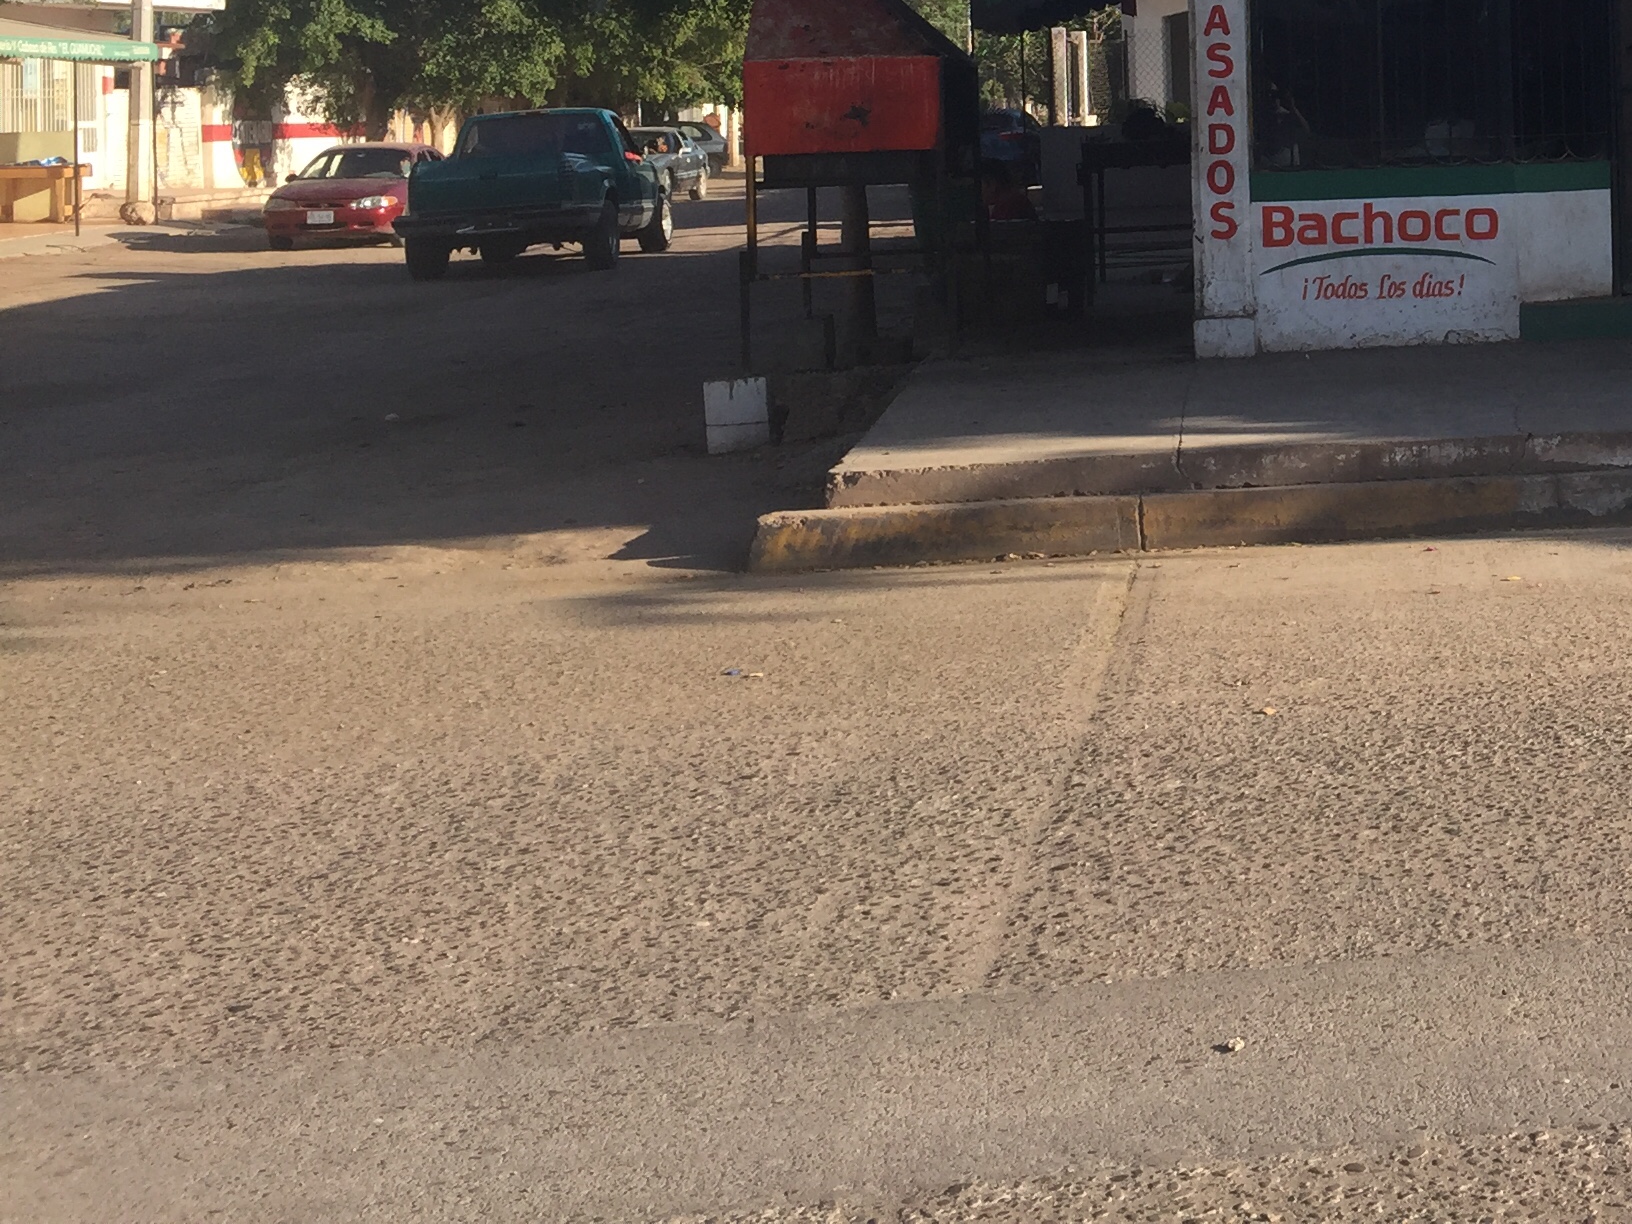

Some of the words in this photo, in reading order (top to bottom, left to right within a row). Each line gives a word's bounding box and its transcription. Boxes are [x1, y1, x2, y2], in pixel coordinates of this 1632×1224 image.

[1204, 4, 1238, 240] ASADOS
[1262, 202, 1500, 248] Bachoco
[1302, 275, 1369, 301] ¡Todos
